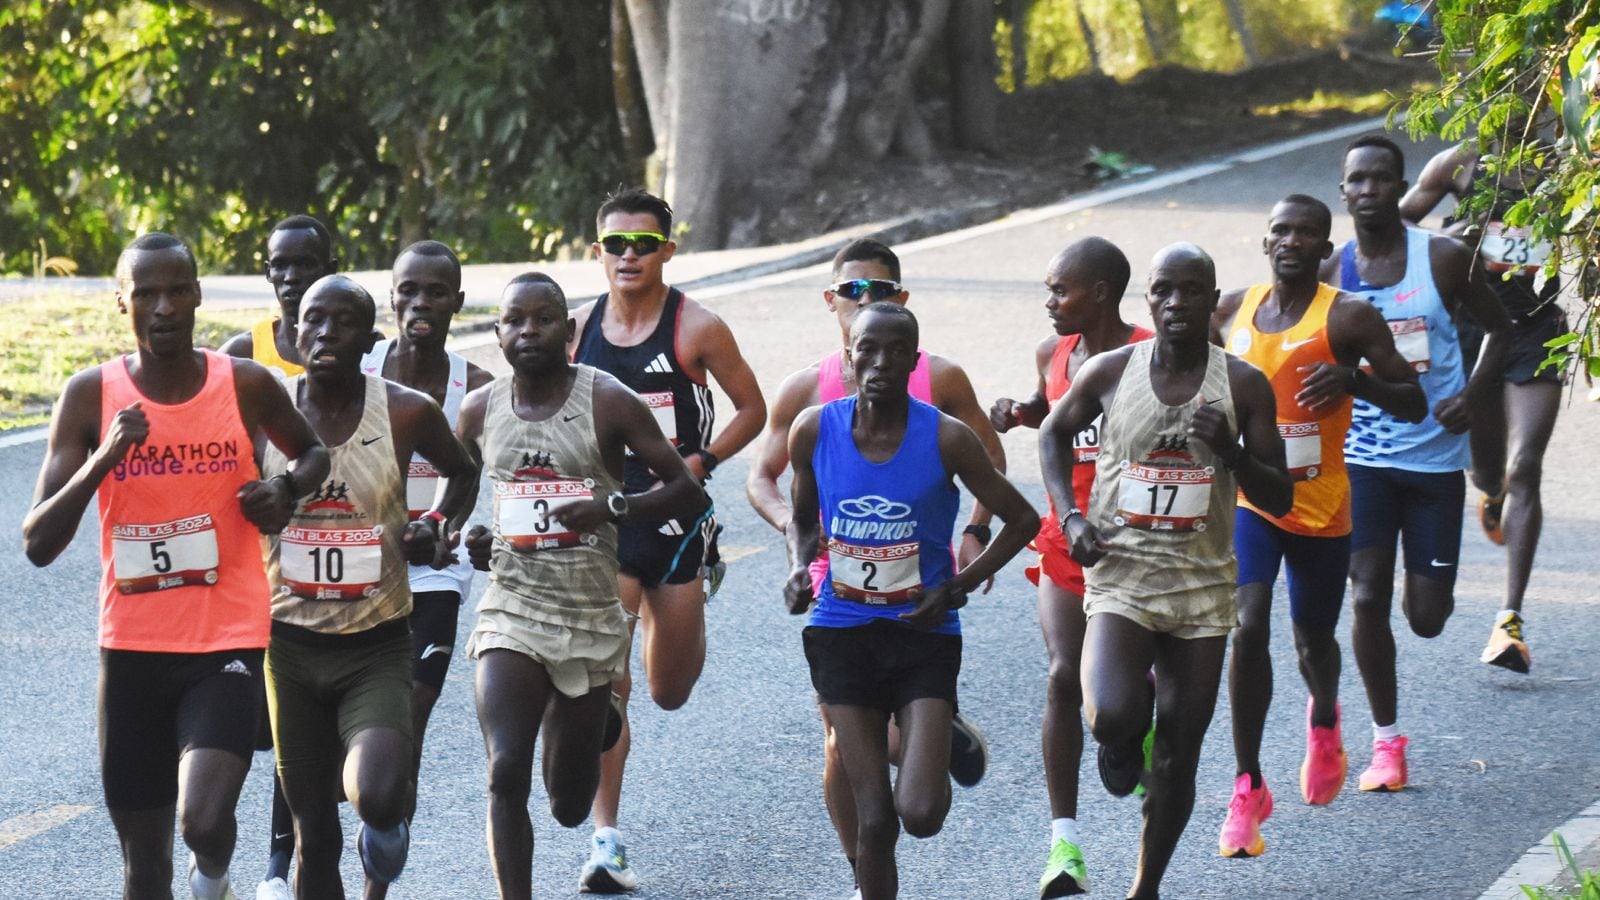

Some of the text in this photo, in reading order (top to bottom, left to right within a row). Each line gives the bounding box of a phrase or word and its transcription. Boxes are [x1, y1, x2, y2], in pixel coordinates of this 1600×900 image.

[1502, 238, 1529, 264] 23
[1289, 424, 1319, 434] 2024
[123, 441, 238, 463] ARATHON
[113, 458, 239, 480] guide.com
[1148, 470, 1178, 480] BLAS
[524, 484, 557, 494] BLAS
[1147, 484, 1179, 515] 17
[112, 516, 213, 537] SAN BLAS 2024
[533, 499, 550, 533] 3
[307, 532, 342, 542] BLAS
[831, 516, 918, 541] OLYMPIKUS
[150, 540, 172, 573] 5
[852, 548, 884, 558] BLAS
[308, 547, 344, 583] 10
[862, 561, 879, 592] 2
